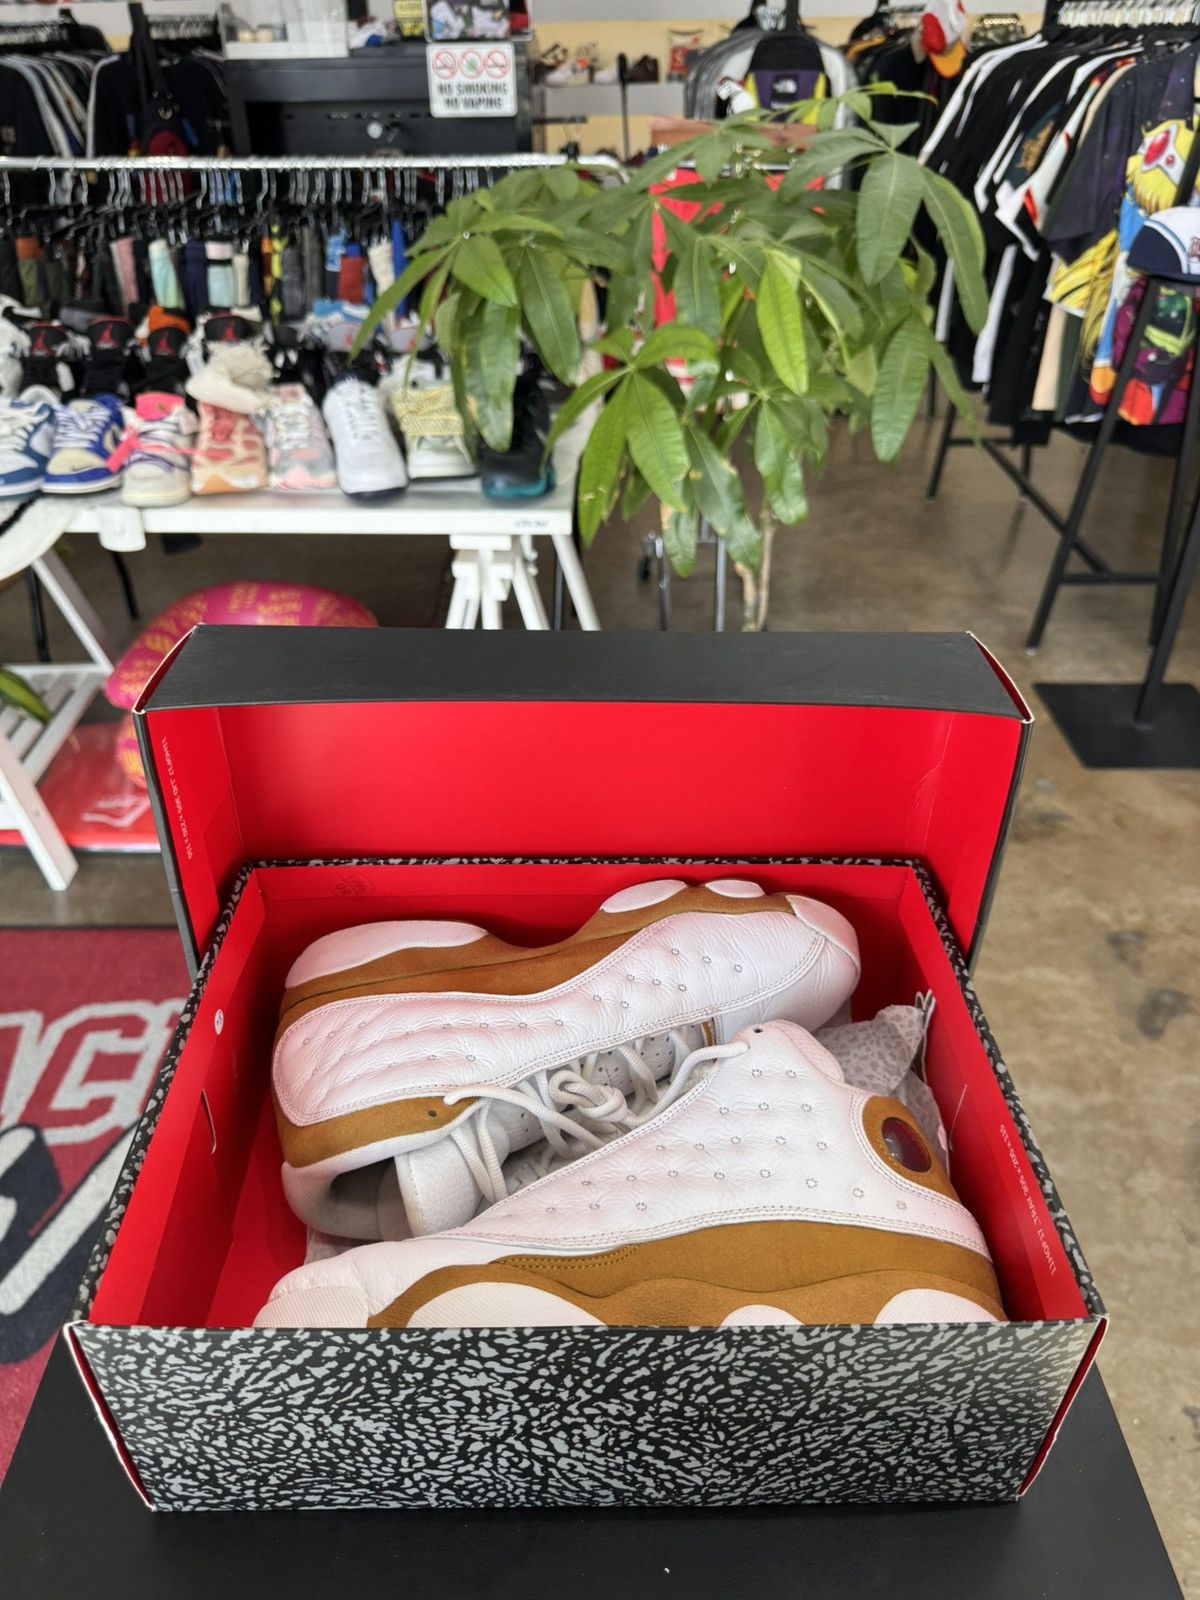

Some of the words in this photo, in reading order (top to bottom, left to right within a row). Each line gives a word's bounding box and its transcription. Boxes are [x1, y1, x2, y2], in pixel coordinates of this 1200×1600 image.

[438, 83, 453, 95] NO
[456, 83, 508, 95] SMOKING
[445, 97, 459, 109] NO
[463, 97, 503, 109] VAPING
